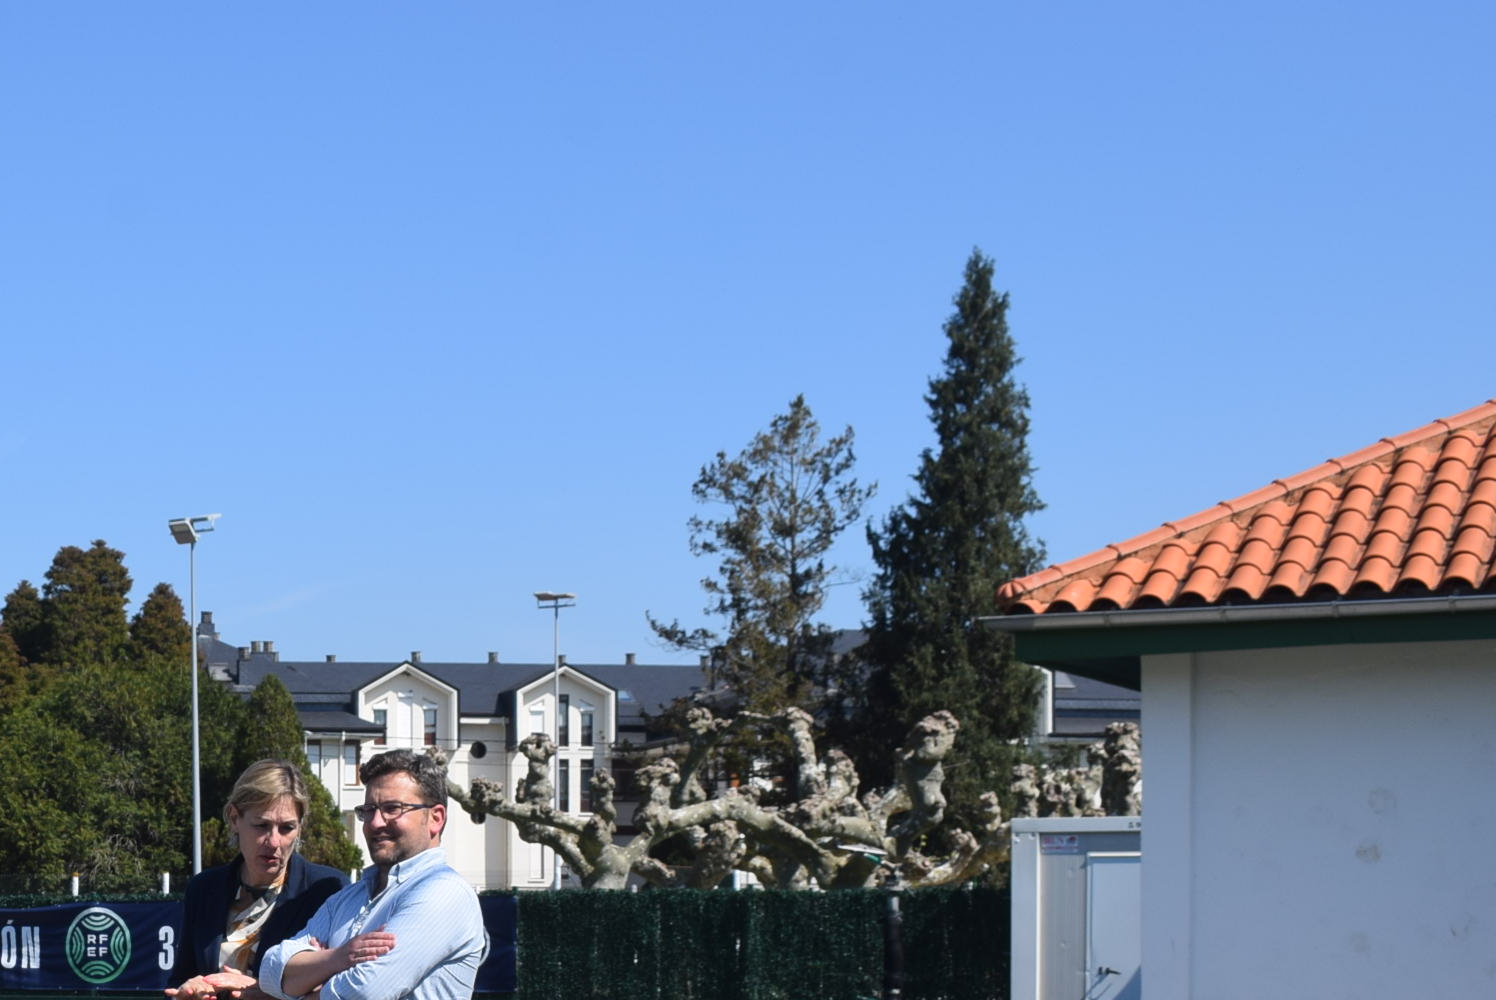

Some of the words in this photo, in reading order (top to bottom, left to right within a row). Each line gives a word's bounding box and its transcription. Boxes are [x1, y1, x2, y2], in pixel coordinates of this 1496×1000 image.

[87, 934, 108, 944] RF
[87, 947, 108, 957] EF
[158, 925, 175, 970] 3
